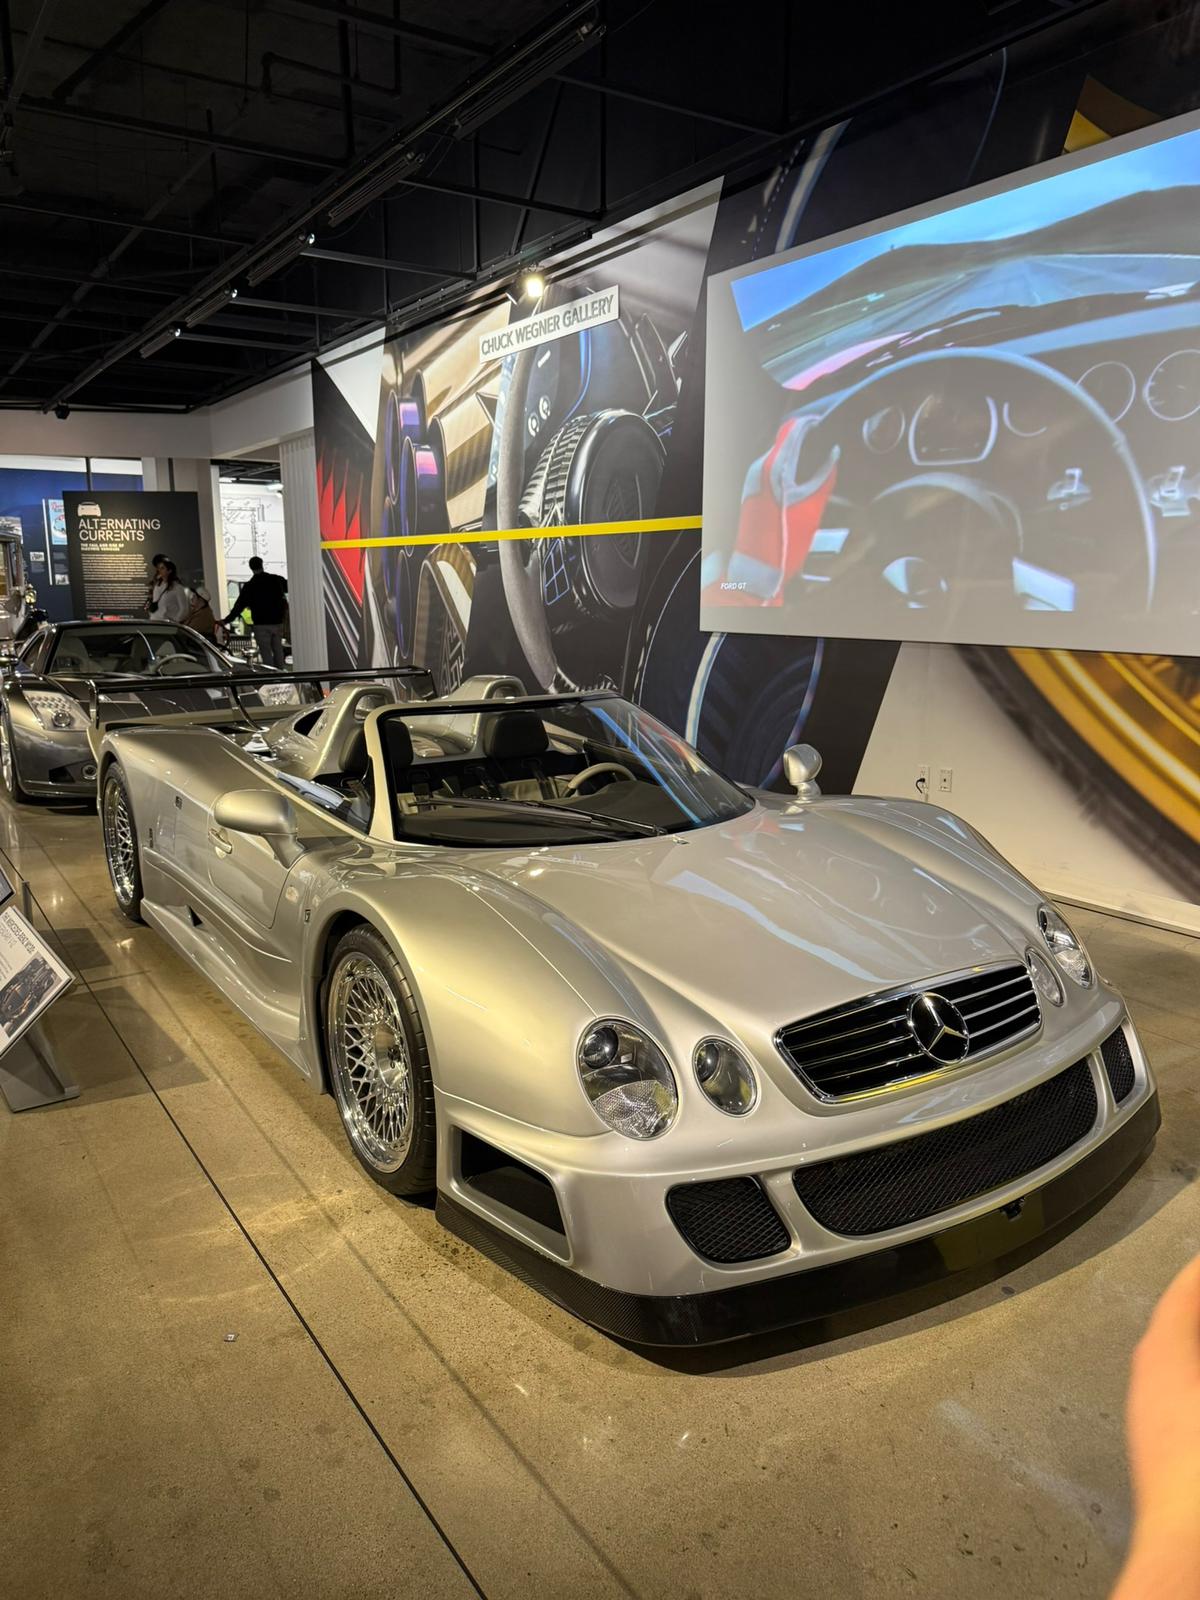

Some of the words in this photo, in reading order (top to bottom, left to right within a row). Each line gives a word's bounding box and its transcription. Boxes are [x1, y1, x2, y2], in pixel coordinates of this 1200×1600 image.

[481, 331, 514, 355] CHUCK
[515, 314, 560, 344] WEGNER
[562, 295, 614, 328] GALLERY
[79, 519, 161, 530] ALTERNATING
[79, 530, 145, 541] CURRENTS
[720, 582, 737, 590] FORD
